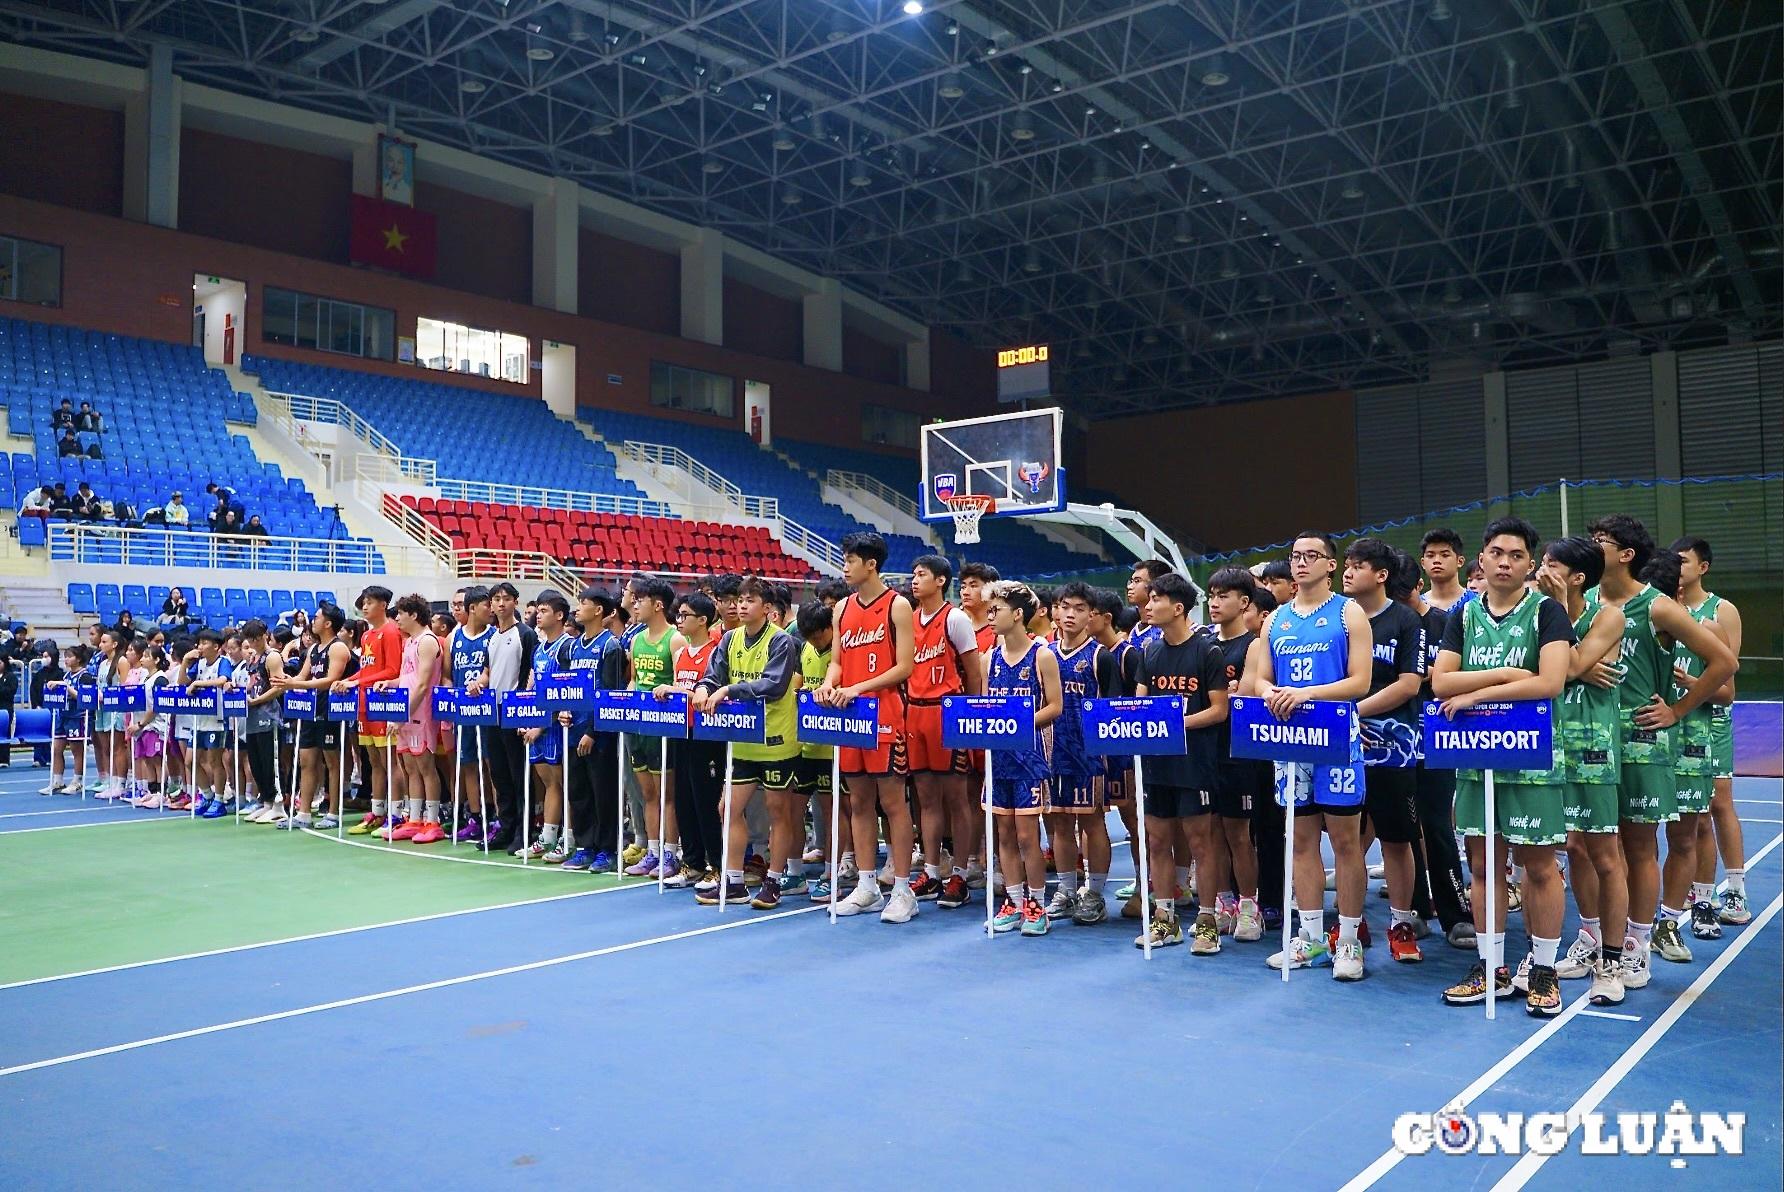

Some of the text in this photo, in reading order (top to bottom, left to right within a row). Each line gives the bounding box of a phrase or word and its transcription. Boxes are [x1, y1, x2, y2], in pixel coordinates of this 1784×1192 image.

[937, 476, 954, 488] VBA
[1273, 635, 1333, 658] Tsunami
[867, 652, 877, 672] 8
[1290, 657, 1313, 682] 32
[930, 665, 945, 685] 17
[546, 685, 584, 700] BA ĐÌNH
[599, 707, 640, 721] BASKET SAG
[802, 714, 842, 732] CHICKEN
[844, 718, 873, 735] DUNK
[957, 718, 1018, 735] THE ZOO
[1098, 717, 1169, 739] ĐỐNG ĐA
[1249, 723, 1329, 747] TSUNAMI
[1434, 730, 1540, 750] ITALYSPORT
[1329, 768, 1356, 794] 32
[1030, 787, 1041, 805] 5
[1073, 787, 1089, 805] 11
[1648, 797, 1659, 808] AN
[1529, 817, 1542, 829] AN
